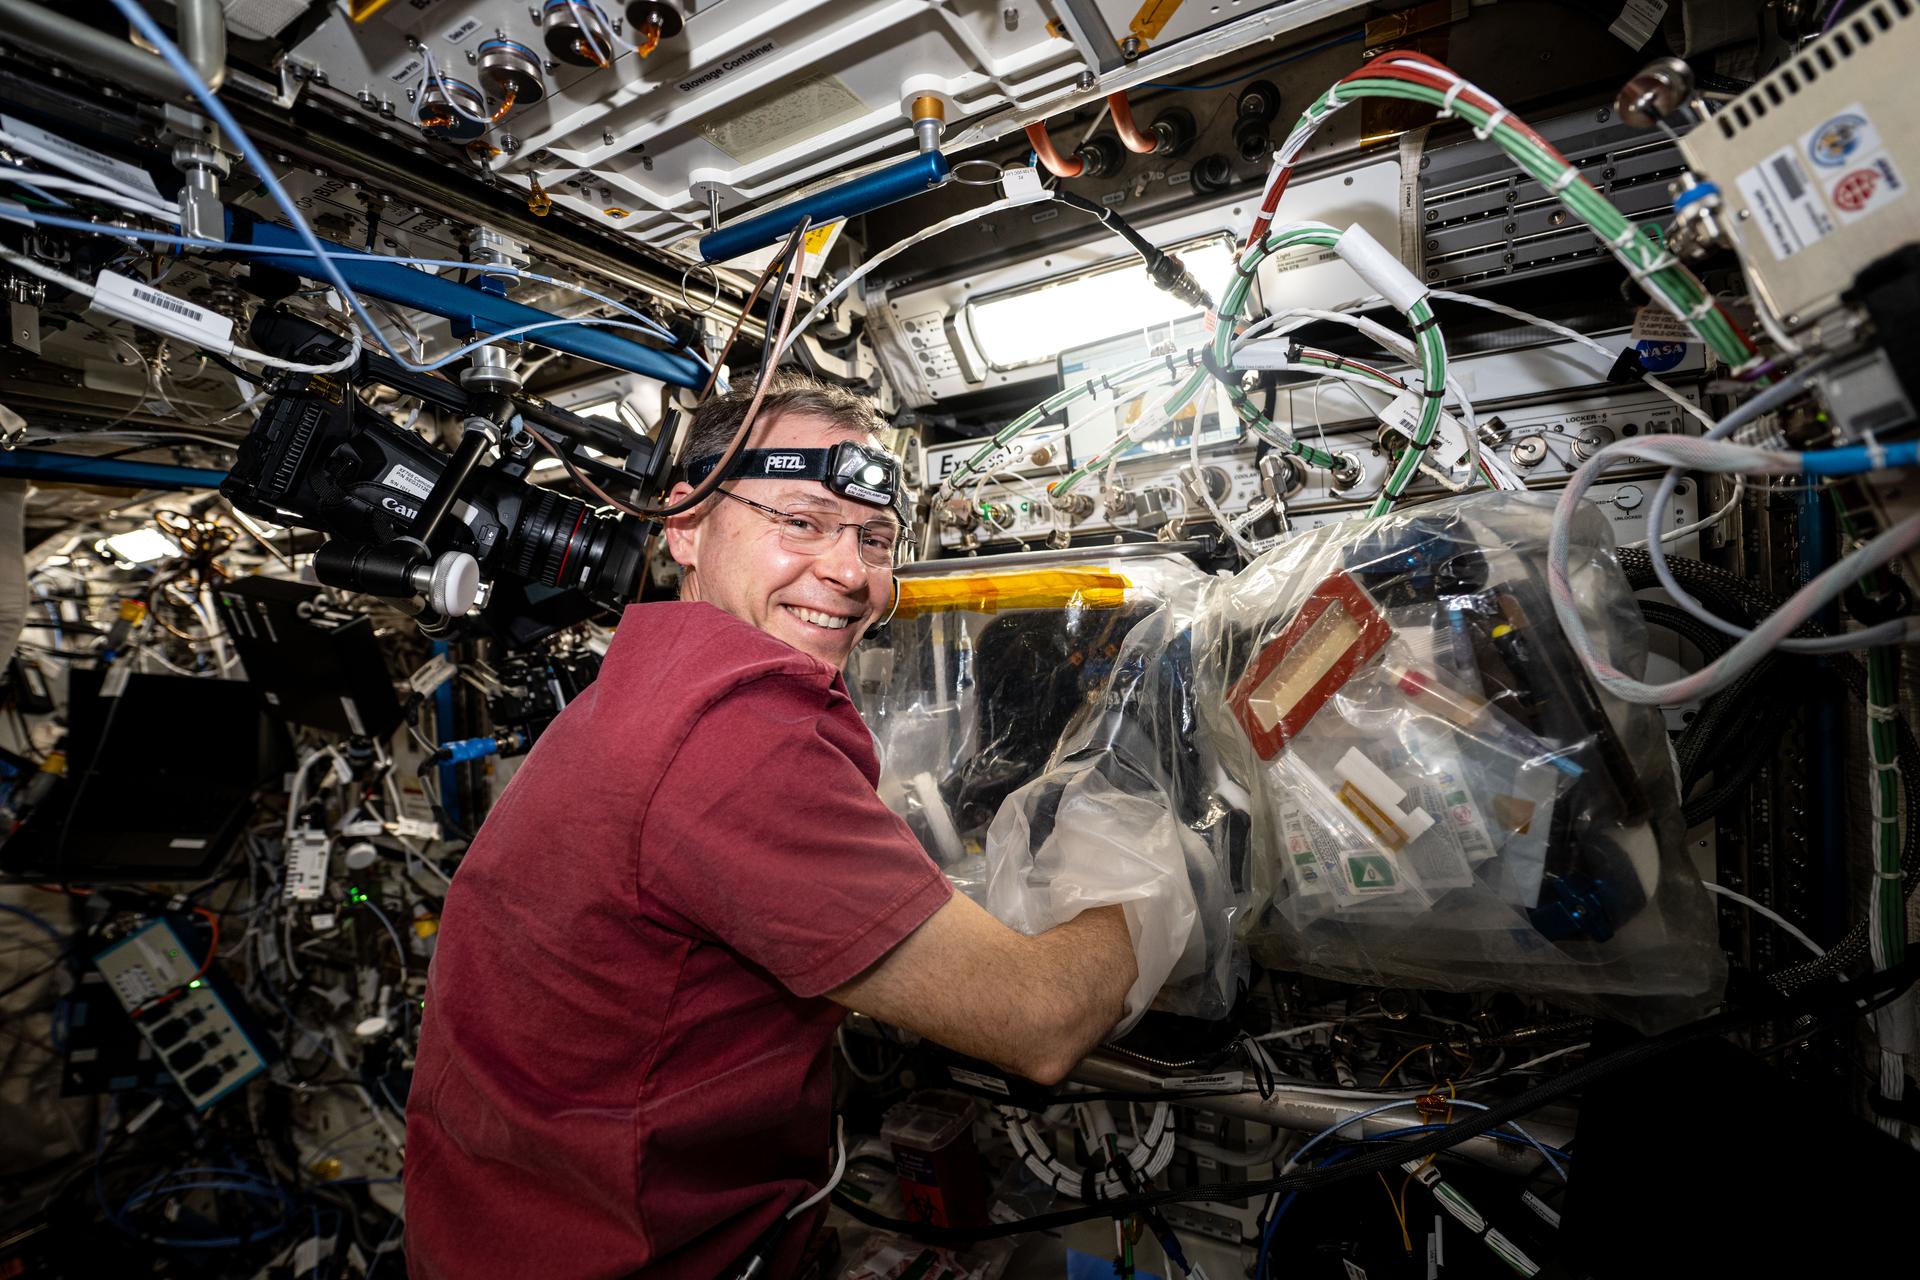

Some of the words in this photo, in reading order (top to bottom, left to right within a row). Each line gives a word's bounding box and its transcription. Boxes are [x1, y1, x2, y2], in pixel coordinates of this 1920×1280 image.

[679, 67, 725, 92] Stowage
[722, 42, 775, 71] Container
[1638, 343, 1684, 359] NASA
[1565, 414, 1596, 424] LOCKER
[764, 455, 807, 474] PETZL
[382, 497, 418, 520] Can
